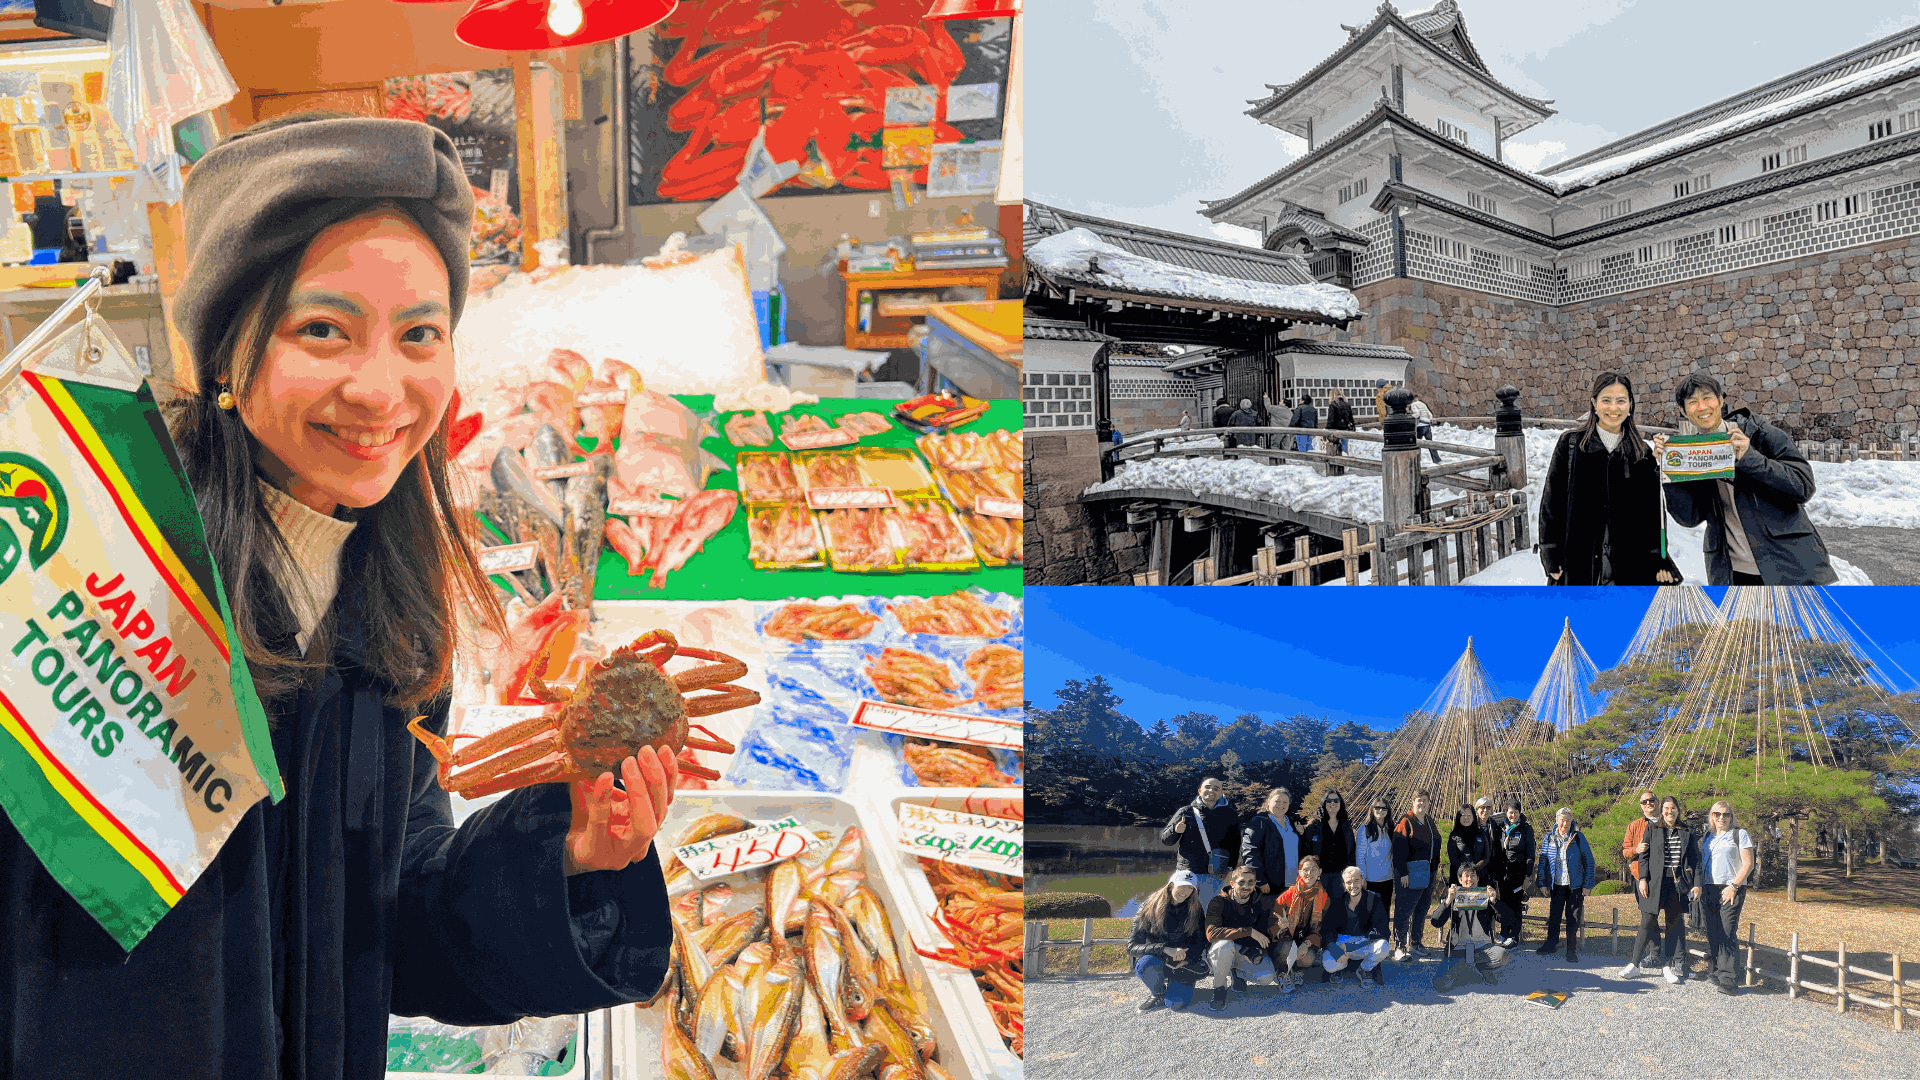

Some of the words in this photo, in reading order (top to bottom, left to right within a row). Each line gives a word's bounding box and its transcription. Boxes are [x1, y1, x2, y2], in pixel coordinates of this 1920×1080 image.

[1688, 453, 1733, 461] PANORAMIC
[11, 618, 124, 758] TOURS
[85, 572, 197, 697] JAPAN
[47, 590, 233, 814] PANORAMIC
